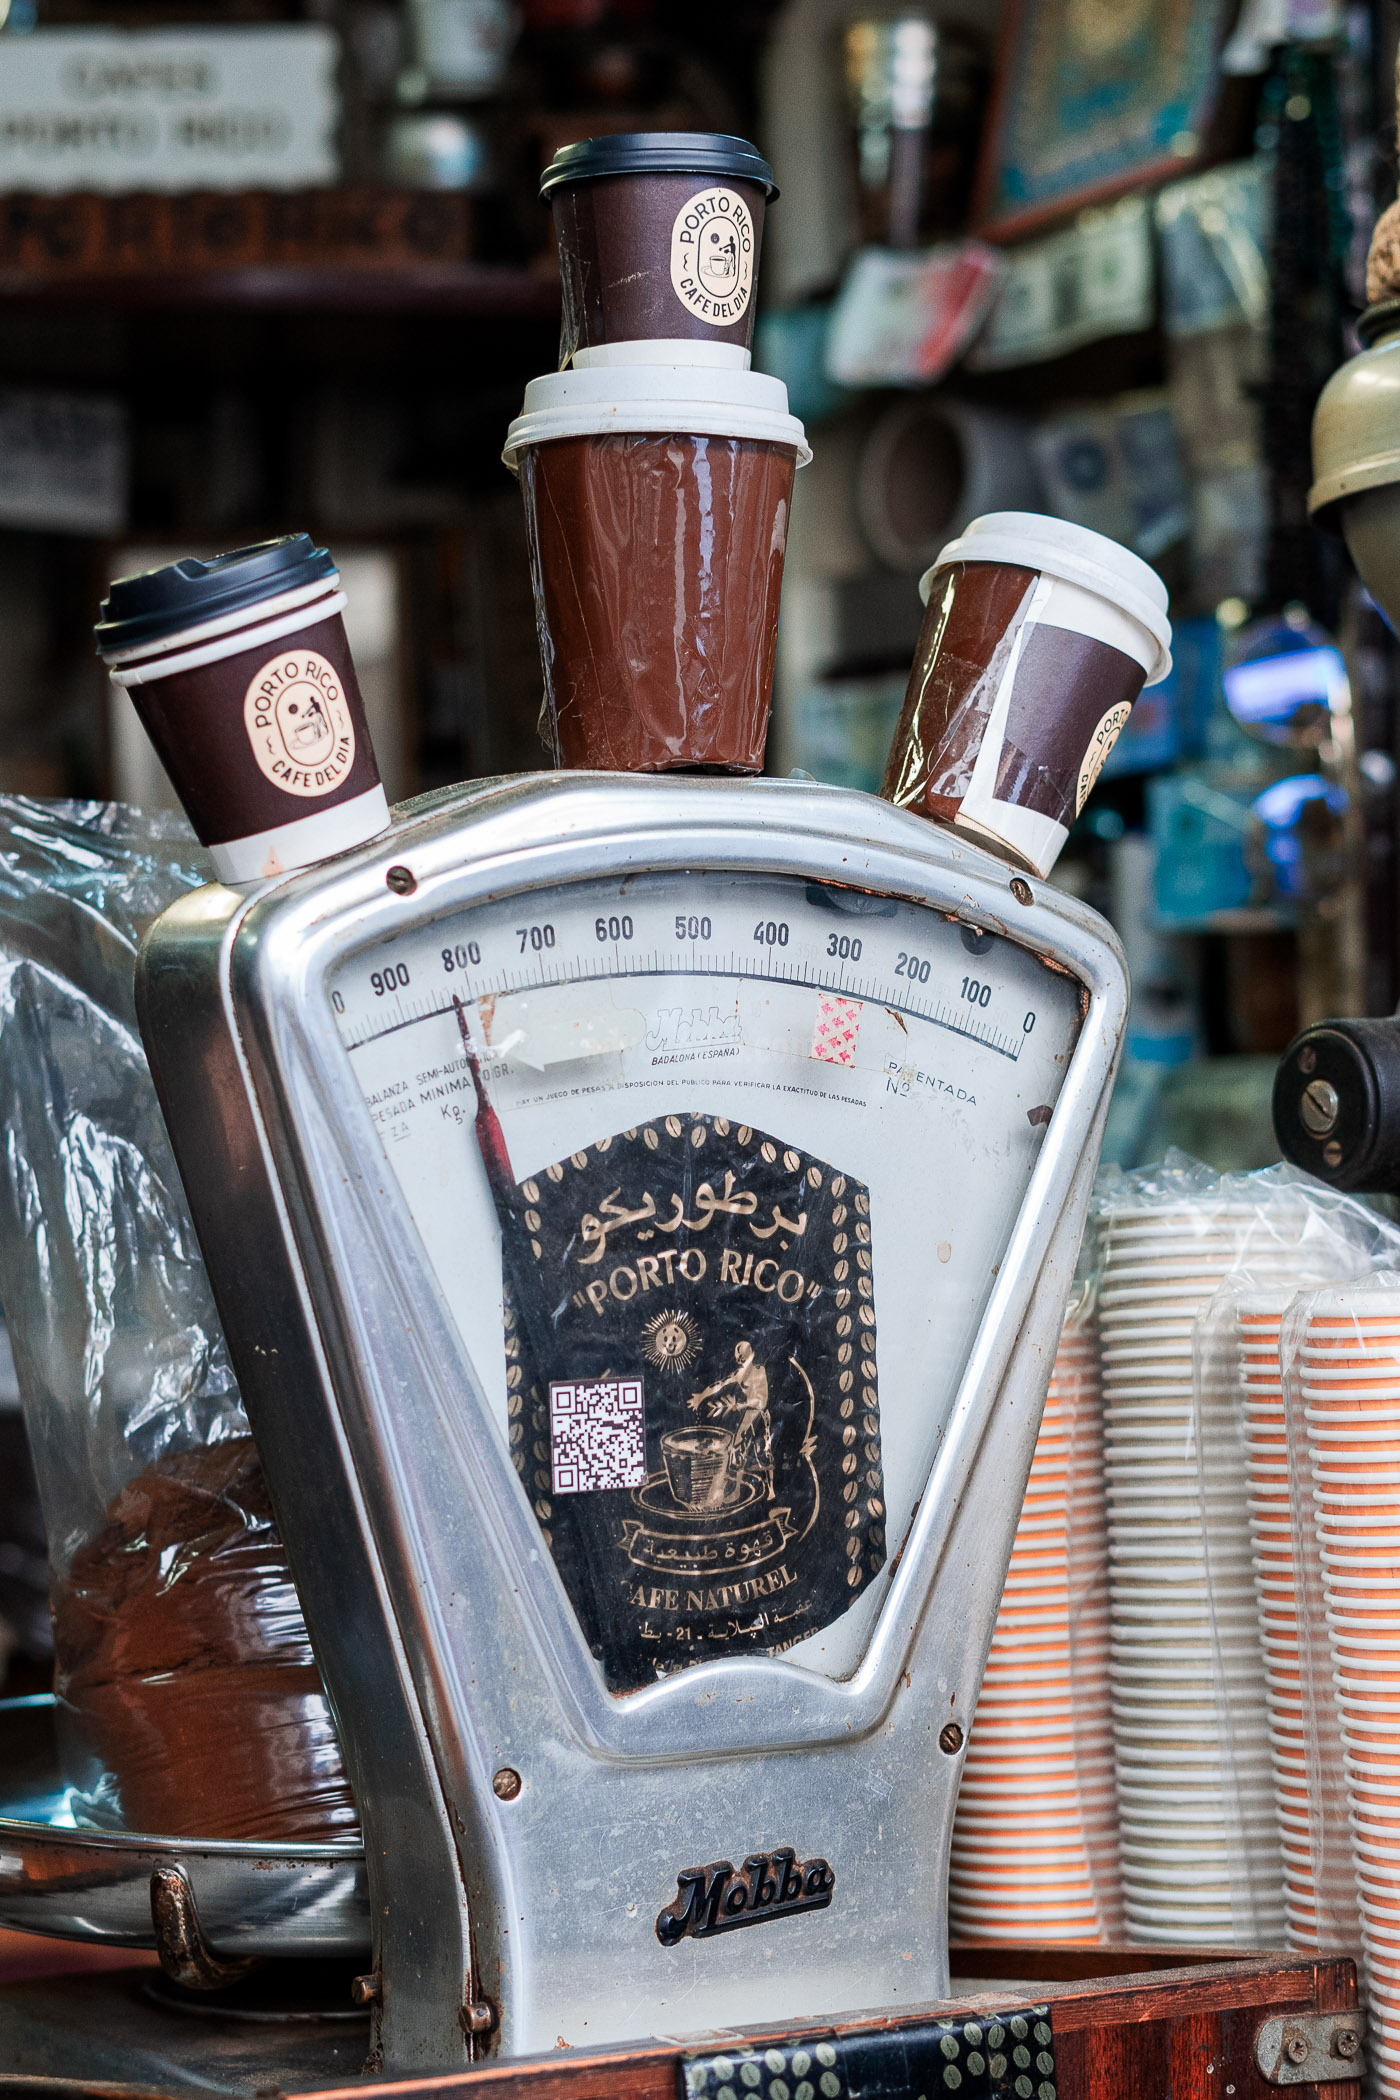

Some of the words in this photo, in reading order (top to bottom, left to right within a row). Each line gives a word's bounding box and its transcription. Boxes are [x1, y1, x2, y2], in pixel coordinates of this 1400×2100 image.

[680, 197, 730, 244] PORTO
[733, 205, 751, 253] RICO
[680, 278, 712, 314] CAFE
[713, 303, 734, 318] DEL
[735, 287, 748, 311] DIA
[255, 662, 298, 728] PORTO
[305, 661, 338, 701] RICO
[272, 760, 312, 787] CAFE
[315, 764, 341, 786] DEL
[336, 737, 350, 763] DIA
[370, 962, 410, 996] 900
[441, 940, 482, 972] 800
[516, 924, 556, 954] 700
[595, 915, 634, 942] 600
[675, 915, 712, 940] 500
[753, 921, 789, 946] 400
[826, 933, 862, 961] 300
[894, 951, 931, 984] 200
[960, 976, 992, 1008] 100
[1022, 1011, 1036, 1034] 0
[651, 1052, 695, 1066] BADALONA
[420, 1076, 471, 1104] MINIMA
[533, 1095, 543, 1103] UN
[546, 1090, 568, 1100] JUEGO
[734, 1080, 771, 1089] VERIFICAR
[773, 1083, 781, 1091] LA
[783, 1085, 818, 1097] EXACTITUD
[819, 1091, 827, 1099] DE
[828, 1093, 840, 1101] LAS
[841, 1095, 867, 1107] PESADAS
[643, 1539, 718, 1569] طبيعية
[724, 1530, 773, 1563] قهوة
[686, 1564, 798, 1611] NATUREL
[676, 1627, 691, 1641] 21
[656, 1850, 834, 1946] Mobba
